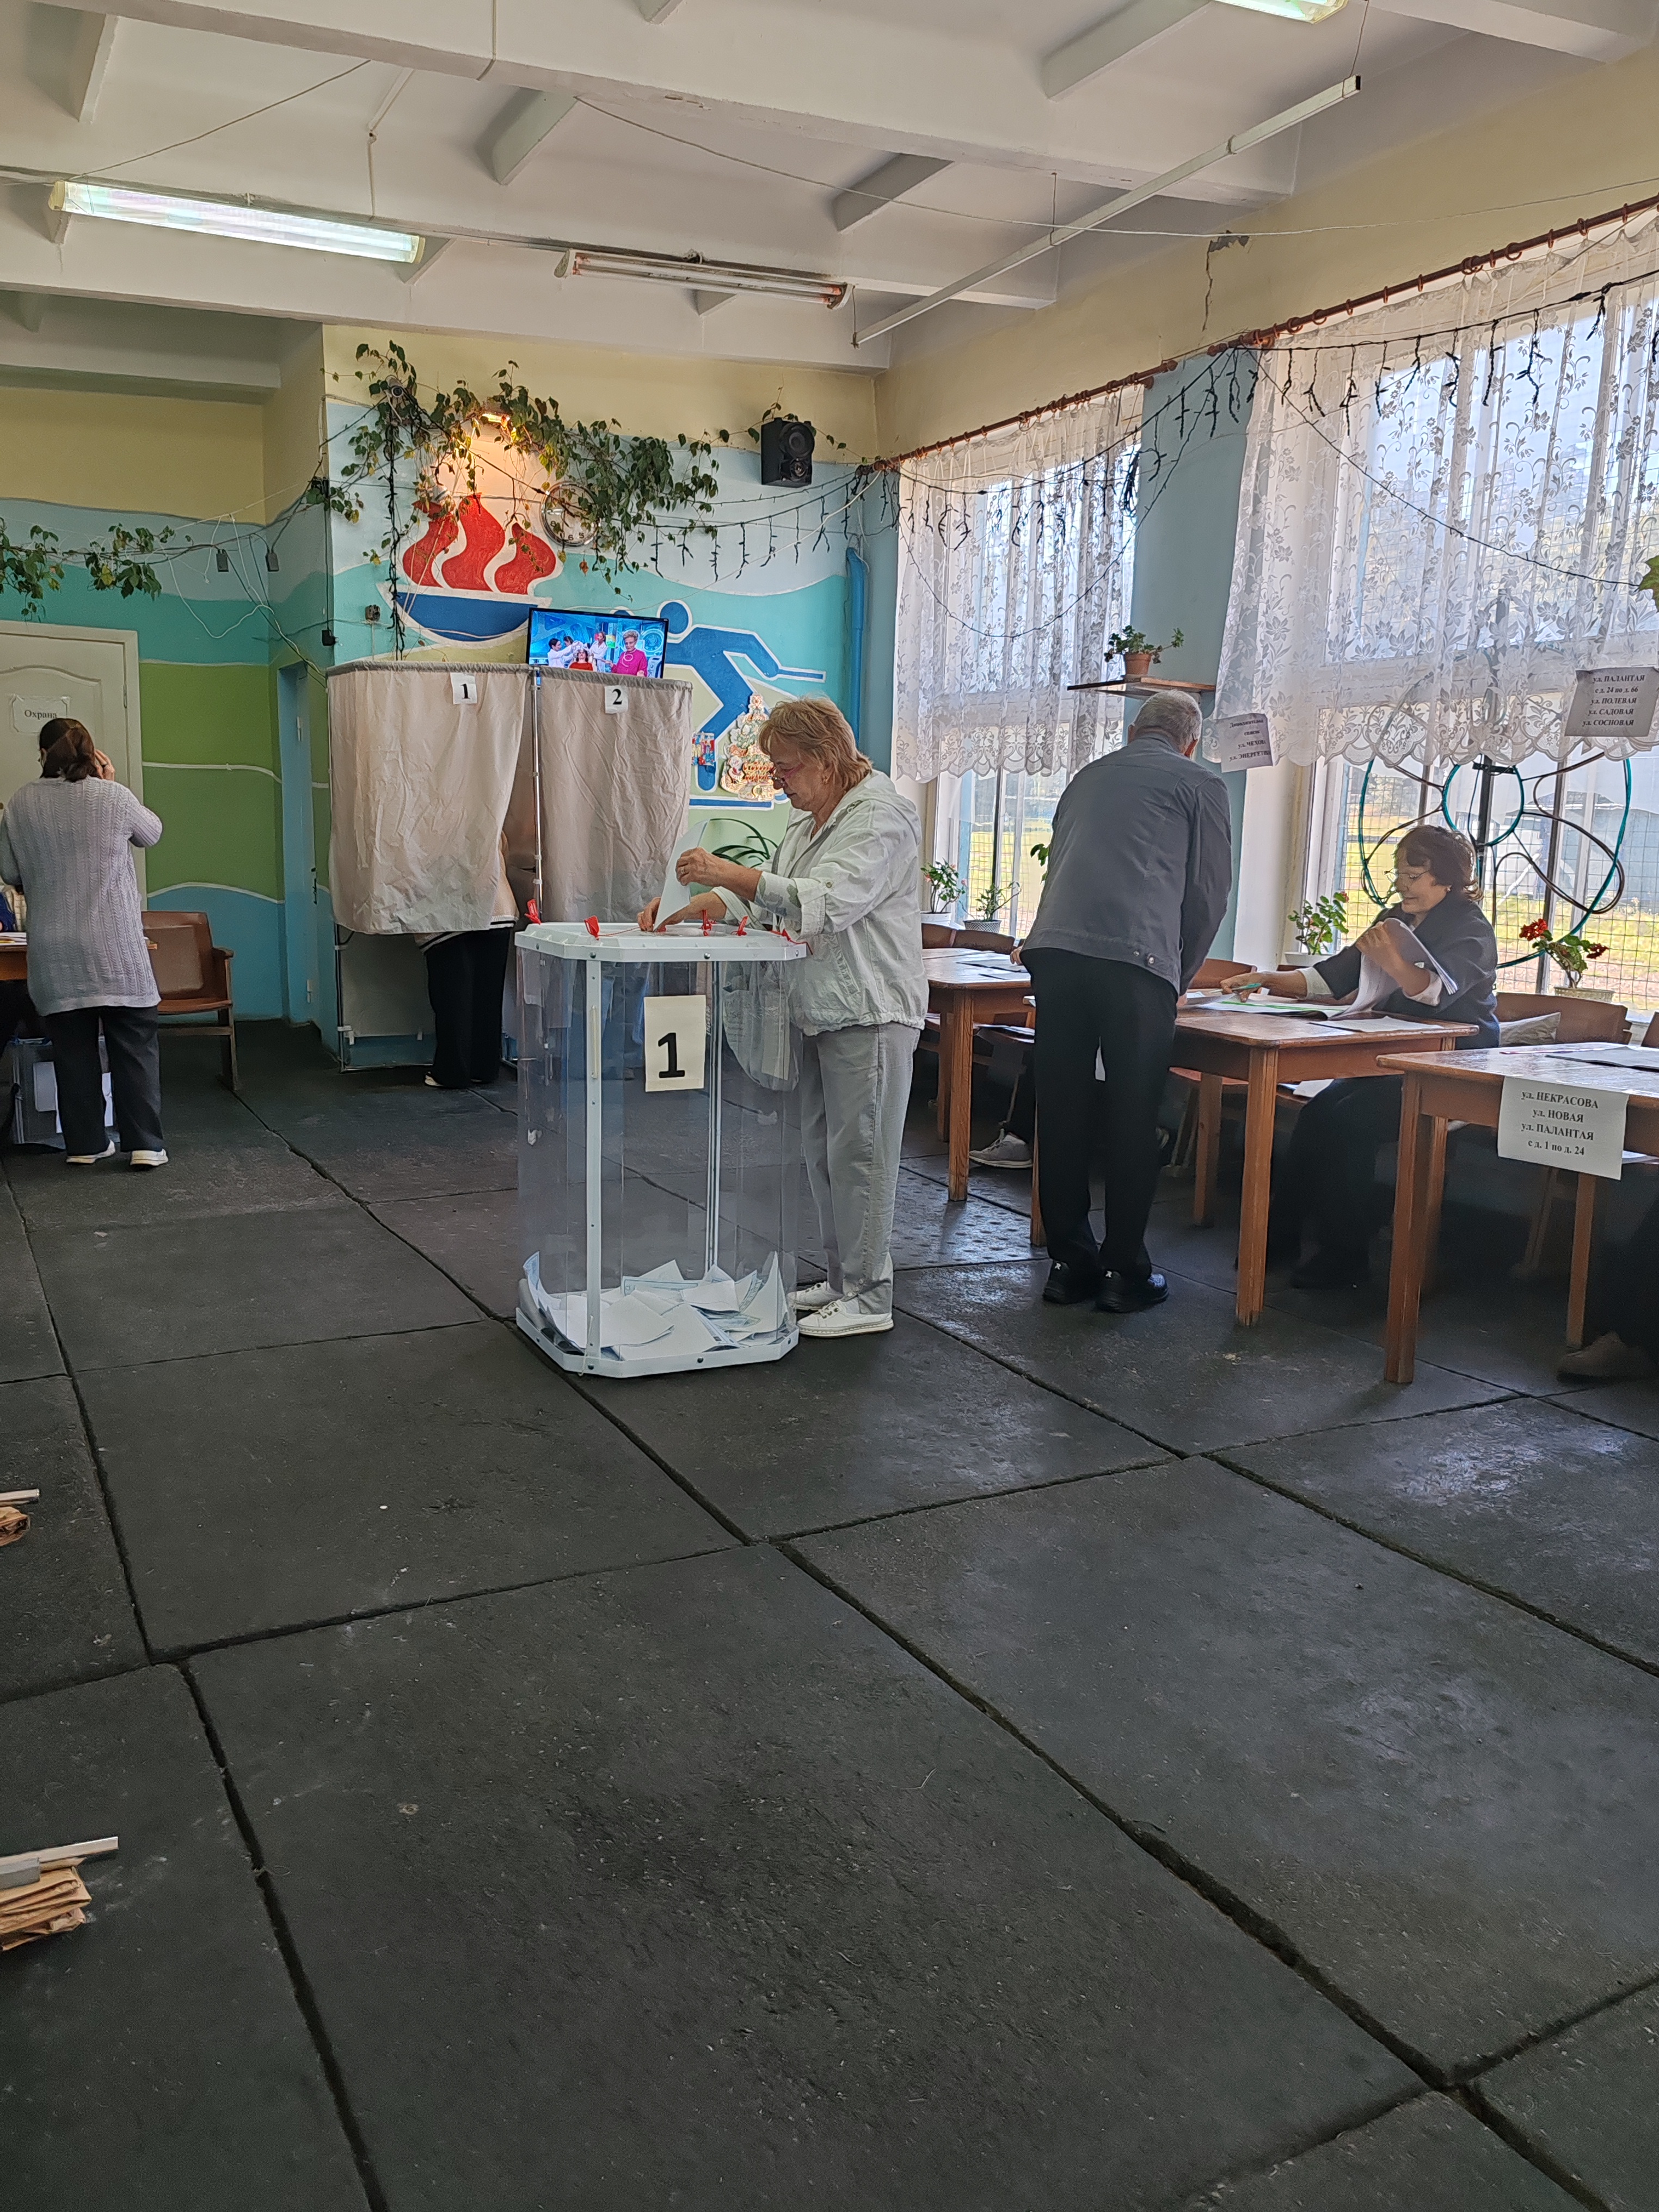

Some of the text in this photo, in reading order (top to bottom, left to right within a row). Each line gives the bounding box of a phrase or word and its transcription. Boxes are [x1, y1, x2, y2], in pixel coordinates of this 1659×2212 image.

[460, 683, 470, 700] 1
[612, 688, 623, 705] 2
[24, 710, 57, 720] Охрана
[658, 1033, 685, 1078] 1
[1521, 1091, 1598, 1109] ул. НЕКРАСОВА
[1532, 1109, 1583, 1122] ул. НОВАЯ
[1521, 1123, 1594, 1140] ул. ПАЛАНТАЯ
[1545, 1141, 1549, 1150] 1
[1574, 1146, 1584, 1155] 24
